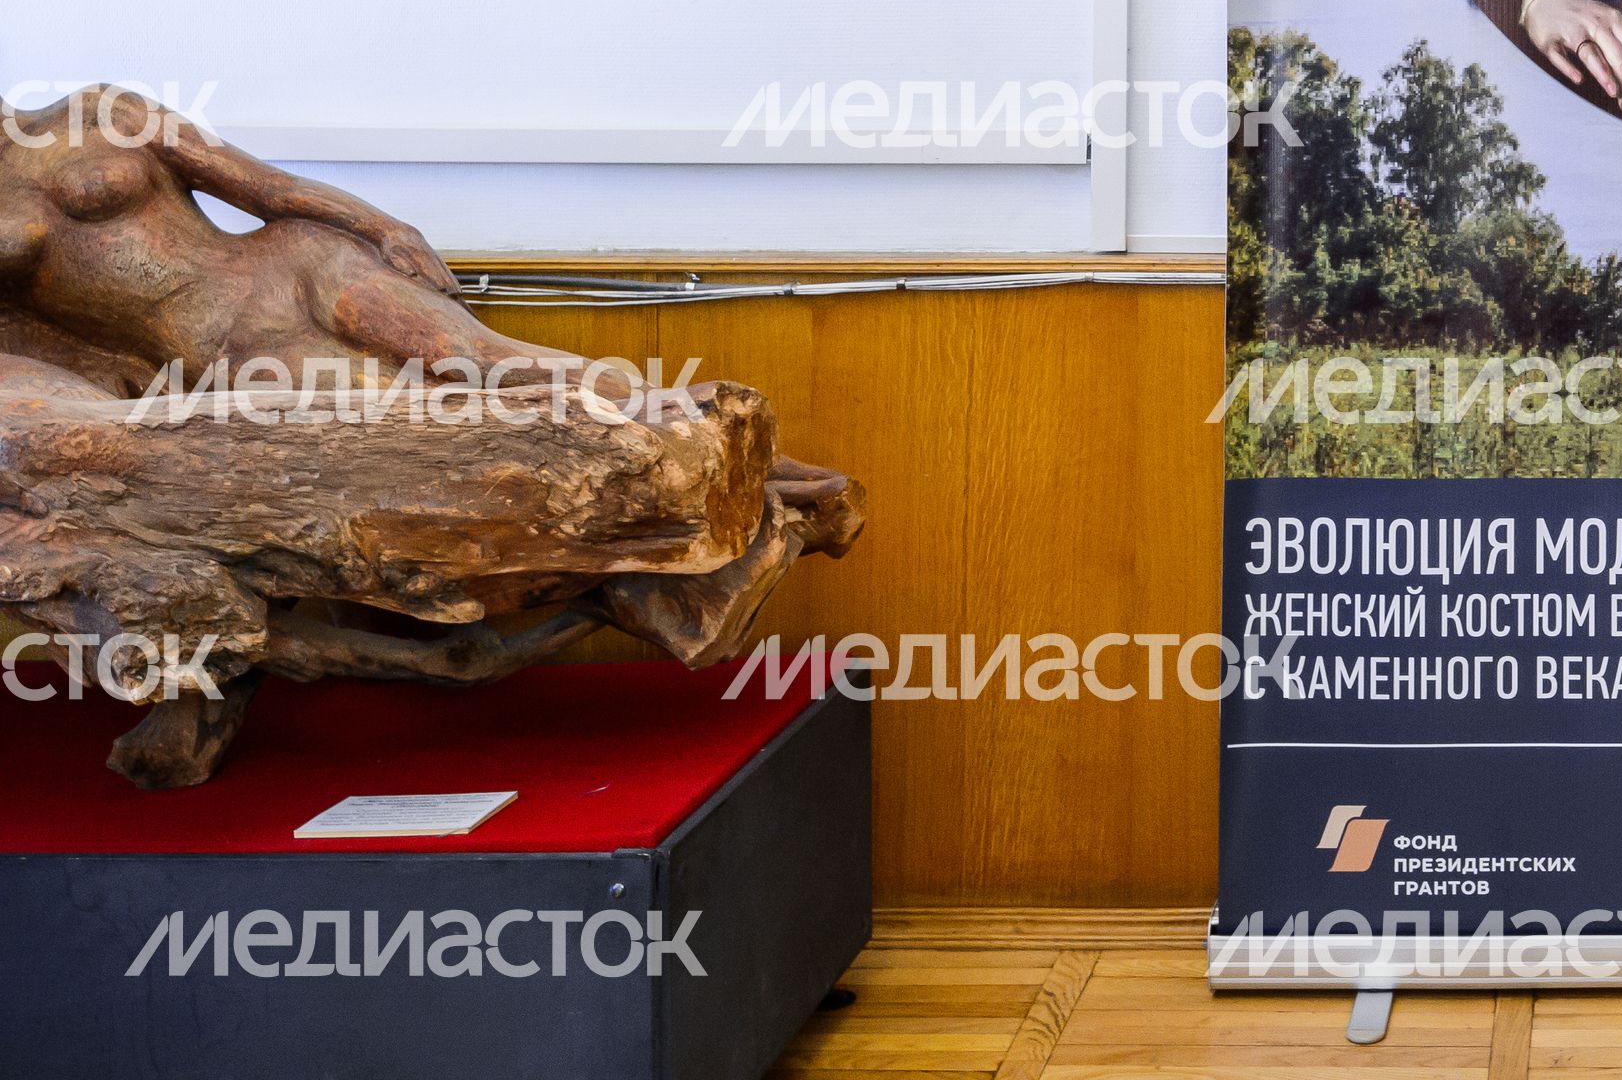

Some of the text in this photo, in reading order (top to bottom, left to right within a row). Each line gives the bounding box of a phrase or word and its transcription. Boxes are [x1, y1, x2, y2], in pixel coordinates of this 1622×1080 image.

[1245, 517, 1515, 585] ЭВОЛЮЦИЯ
[1244, 586, 1426, 638] ЖЕНСКИЙ
[1441, 593, 1596, 638] КОСТЮМ
[1244, 655, 1266, 700] С
[1282, 655, 1519, 700] КАМЕННОГО
[1393, 834, 1458, 852] ФОНД
[1393, 857, 1577, 875] ПРЕЗИДЕНТСКИХ
[1393, 880, 1491, 896] ГРАНТОВ
